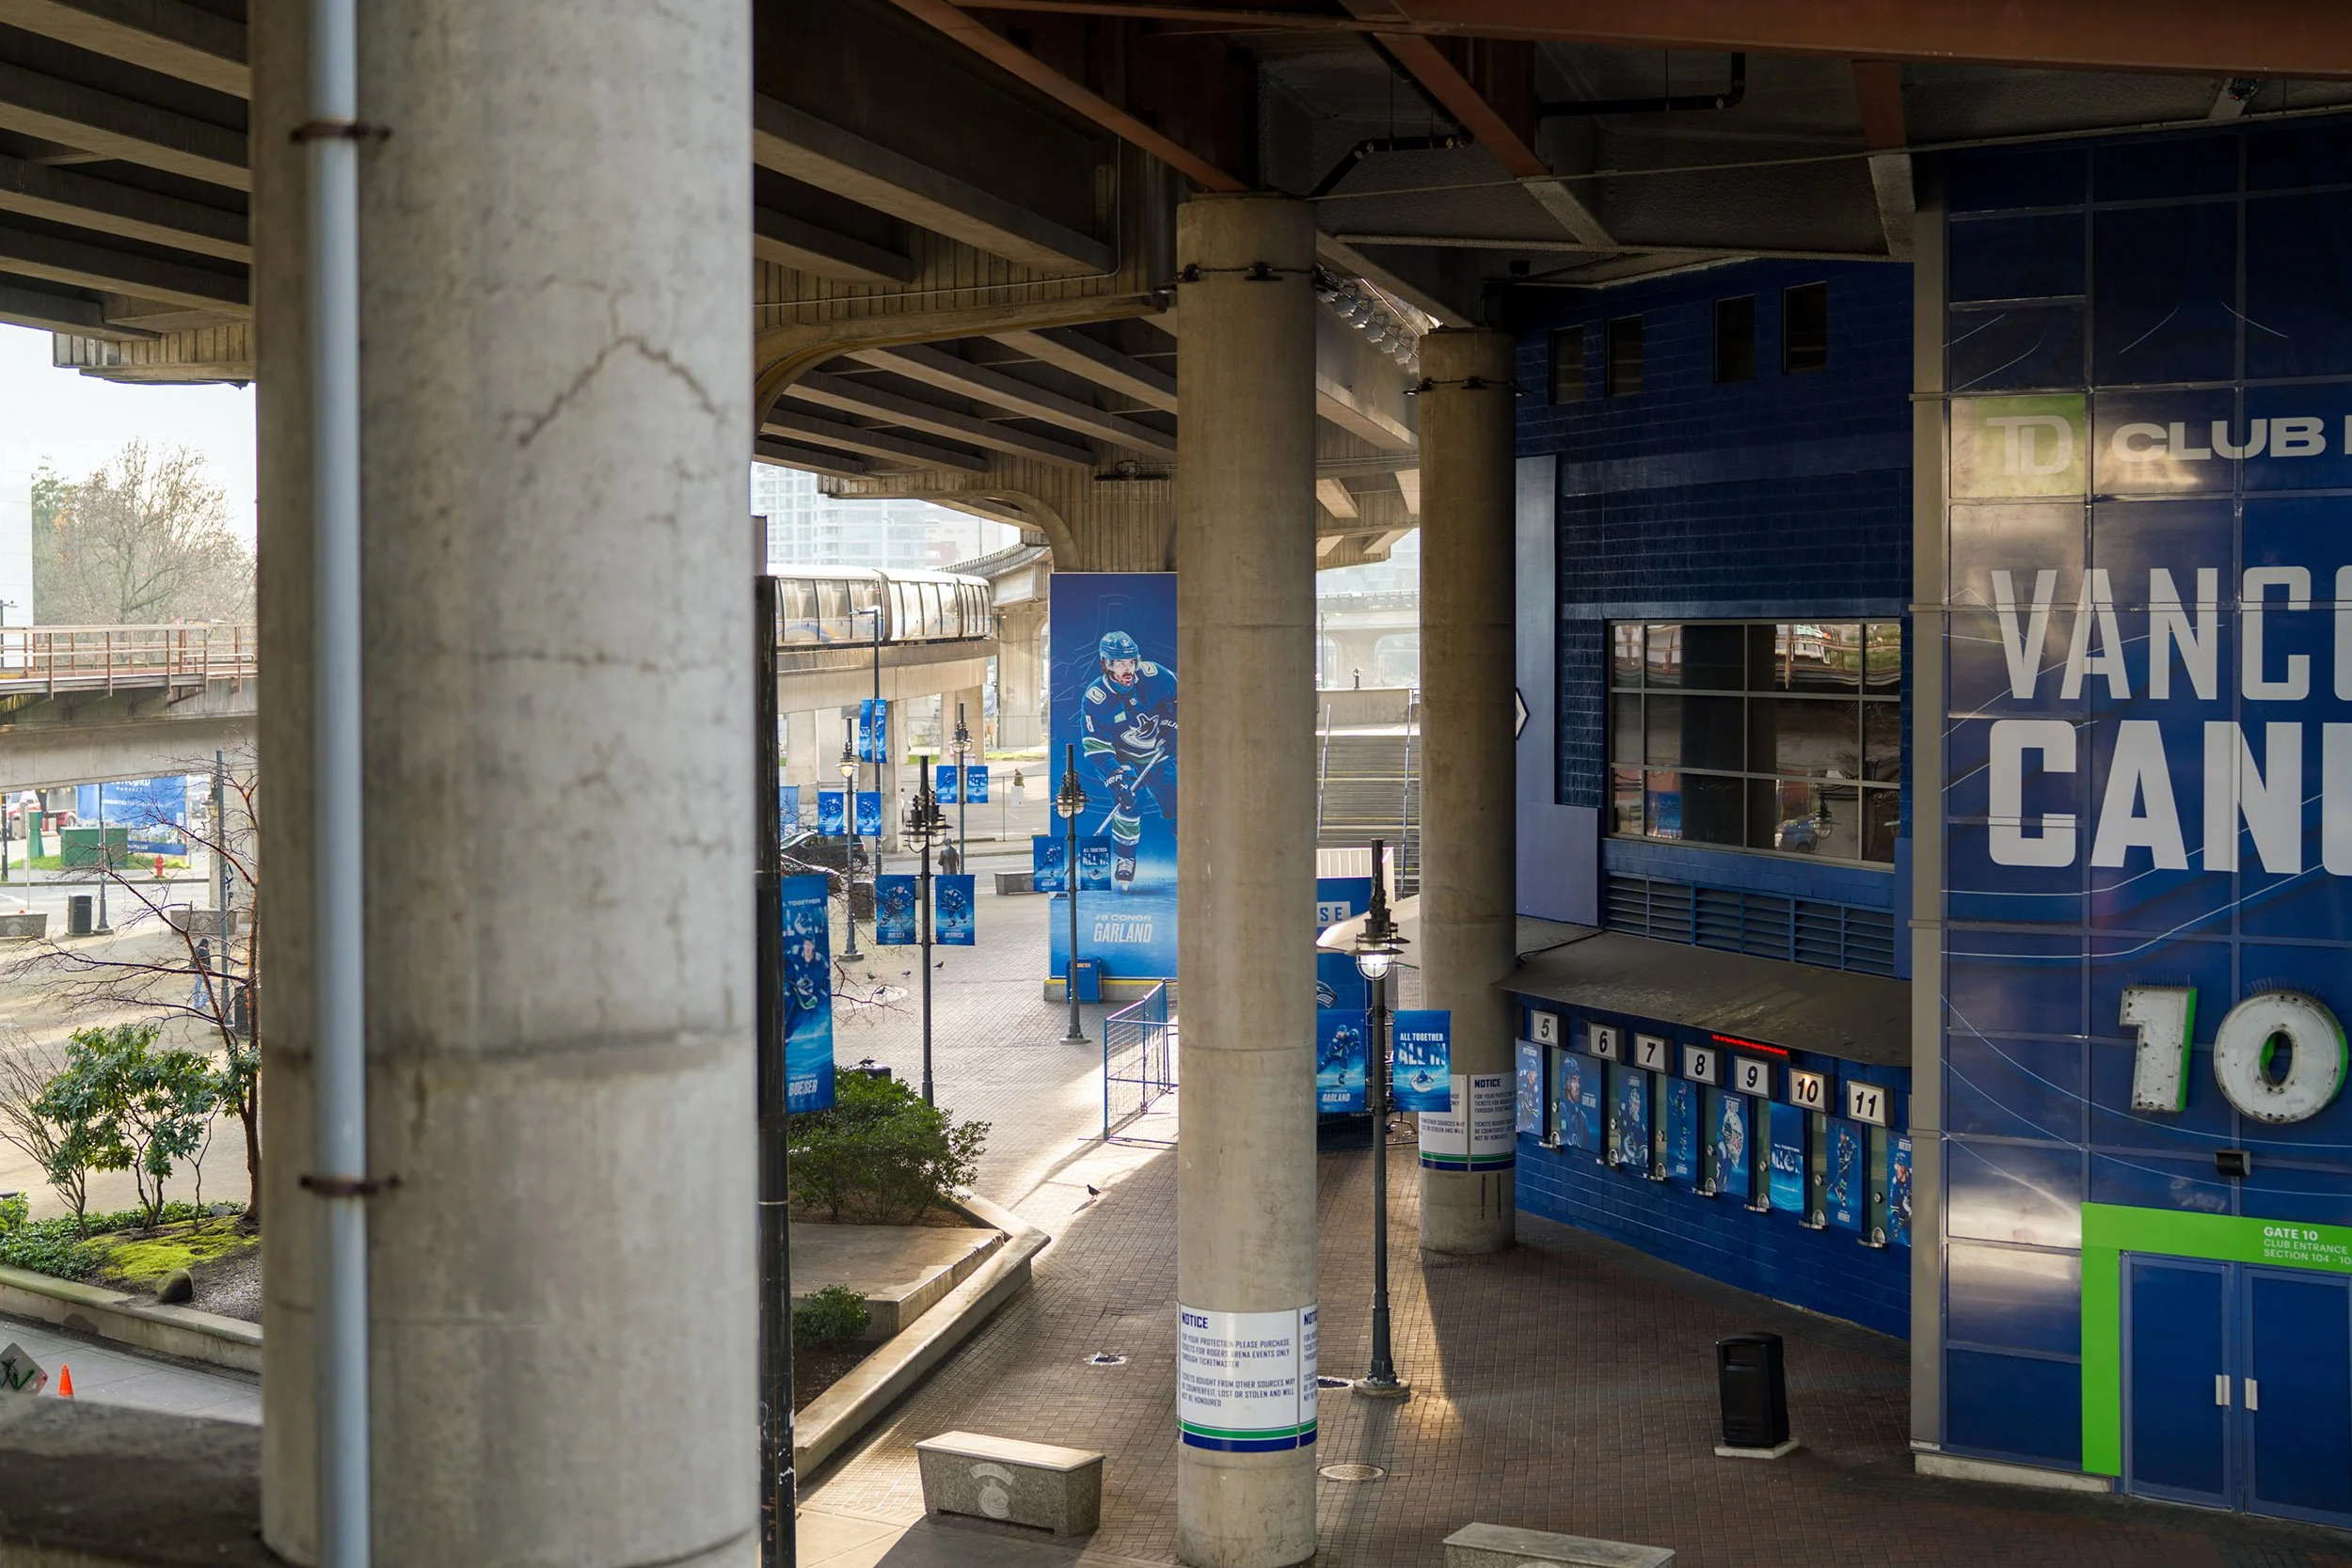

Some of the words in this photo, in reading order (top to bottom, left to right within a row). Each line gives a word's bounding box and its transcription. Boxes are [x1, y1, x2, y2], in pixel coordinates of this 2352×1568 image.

[1986, 414, 2074, 476] TD
[2111, 417, 2327, 462] CLUB
[1992, 565, 2352, 701] VANC
[1093, 923, 1152, 942] GARLAND
[1541, 1018, 1550, 1038] 5
[1400, 1033, 1410, 1041] ALL
[1412, 1033, 1444, 1041] TOGETHER
[1599, 1031, 1608, 1053] 6
[1398, 1042, 1425, 1066] ALL
[1430, 1042, 1446, 1066] IN
[1646, 1041, 1656, 1063] 7
[2119, 986, 2348, 1124] 10
[1694, 1053, 1705, 1076] 8
[1474, 1079, 1501, 1088] NOTICE
[1746, 1066, 1757, 1087] 9
[788, 1079, 818, 1097] BOESER
[1797, 1078, 1819, 1103] 10
[1323, 1093, 1350, 1101] GARLAND
[1855, 1091, 1877, 1117] 11
[2264, 1227, 2298, 1240] GATE
[2302, 1230, 2318, 1241] 10
[2264, 1239, 2290, 1248] CLUB
[2294, 1242, 2347, 1255] ENTRANCE
[2264, 1248, 2309, 1260] SECTION
[2312, 1254, 2329, 1262] 104
[2339, 1257, 2352, 1265] 10
[1182, 1312, 1208, 1329] NOTICE
[1182, 1342, 1195, 1353] TICKETS
[1196, 1346, 1205, 1354] FOR
[1207, 1348, 1228, 1357] ROGERS
[1276, 1349, 1290, 1357] ONLY
[1188, 1335, 1199, 1343] YOUR
[1200, 1337, 1233, 1348] PROTECTION
[1261, 1338, 1290, 1347] PURCHASE
[1182, 1353, 1198, 1363] THROUGH
[1200, 1357, 1239, 1369] TICKETMASTER
[1182, 1371, 1195, 1383] TICKETS
[1196, 1376, 1216, 1386] BOUGHT
[1257, 1379, 1284, 1387] SOURCES
[1188, 1394, 1193, 1402] BE
[1194, 1396, 1221, 1407] HONOURED
[1218, 1389, 1232, 1398] LOST
[1245, 1390, 1267, 1399] STOLEN
